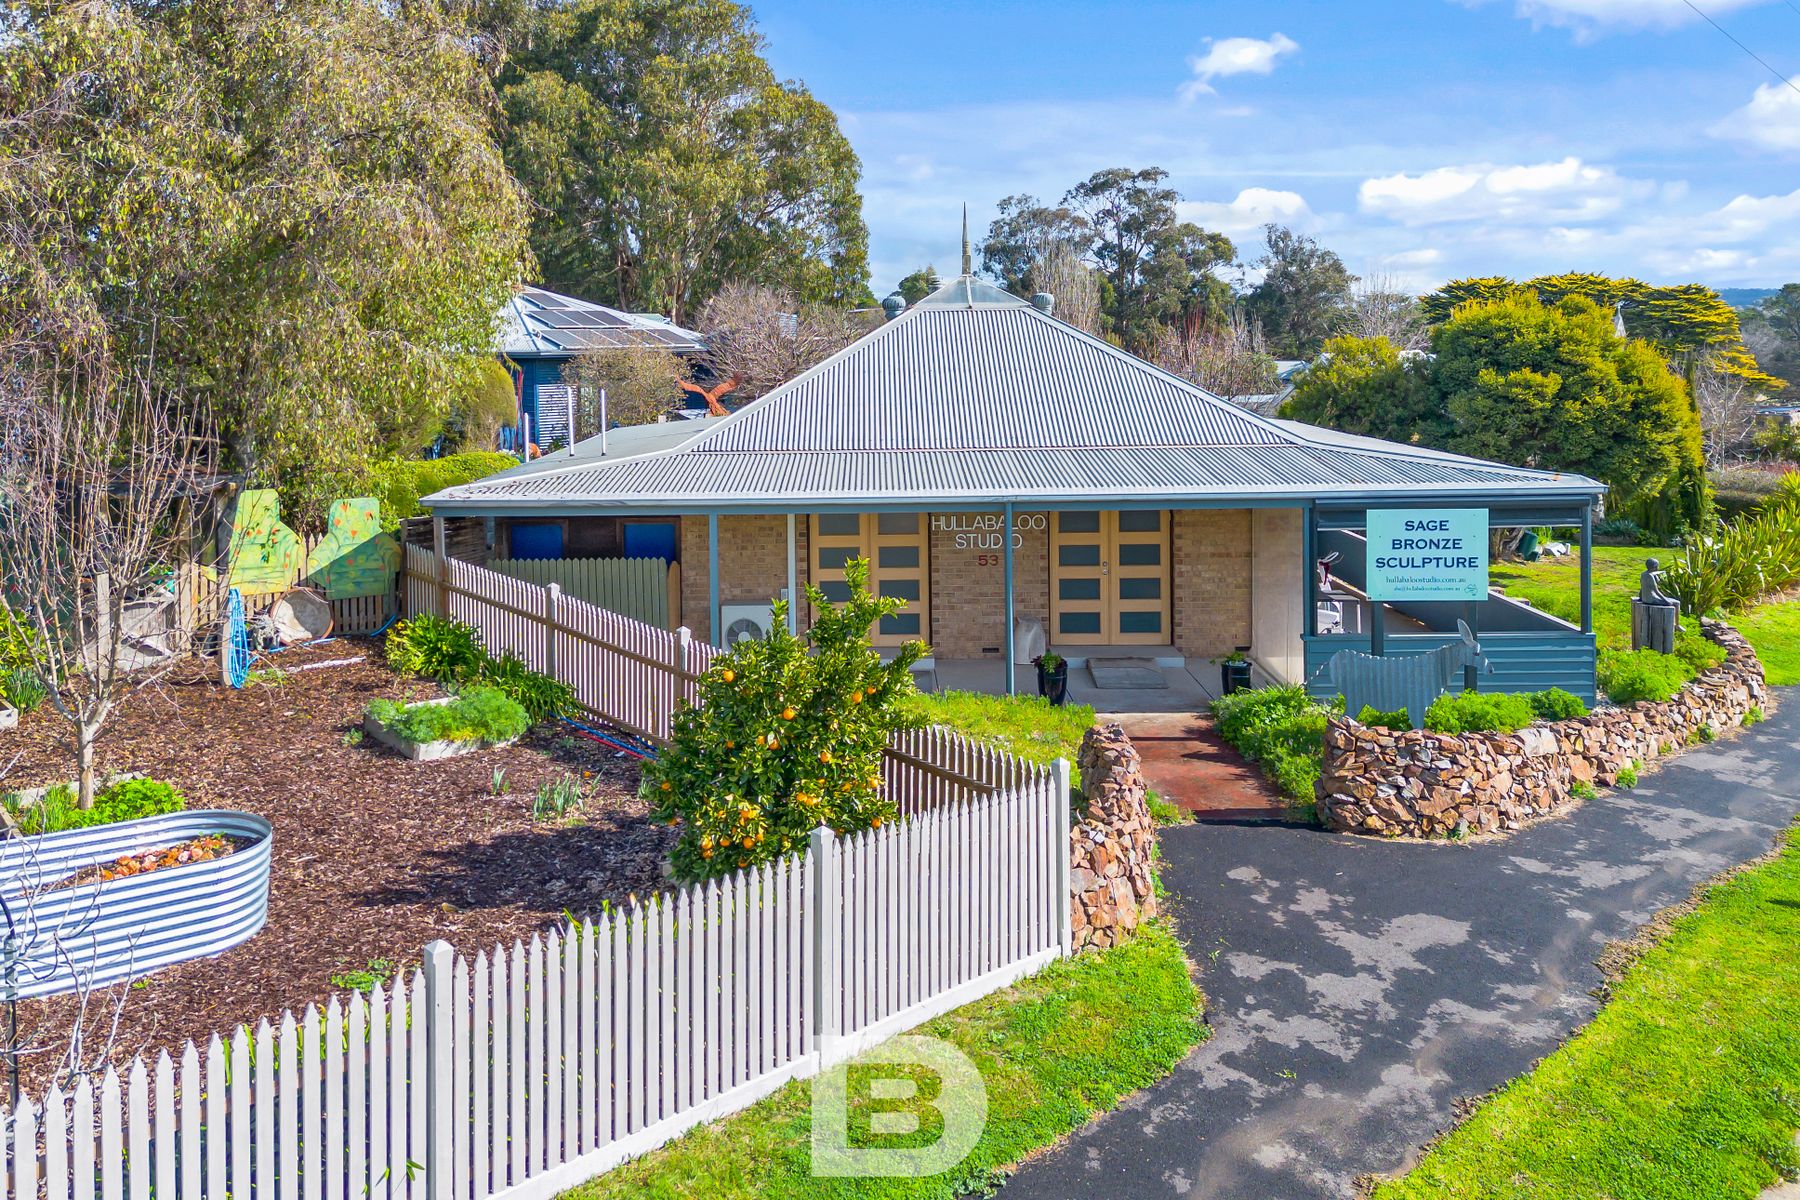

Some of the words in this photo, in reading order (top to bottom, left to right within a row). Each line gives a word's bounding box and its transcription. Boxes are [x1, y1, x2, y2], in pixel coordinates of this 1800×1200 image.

[1404, 519, 1450, 532] SAGE
[955, 533, 1023, 549] STUDO
[1391, 538, 1463, 550] BRONZE
[978, 554, 999, 567] 53
[1375, 556, 1479, 569] SCULPTURE
